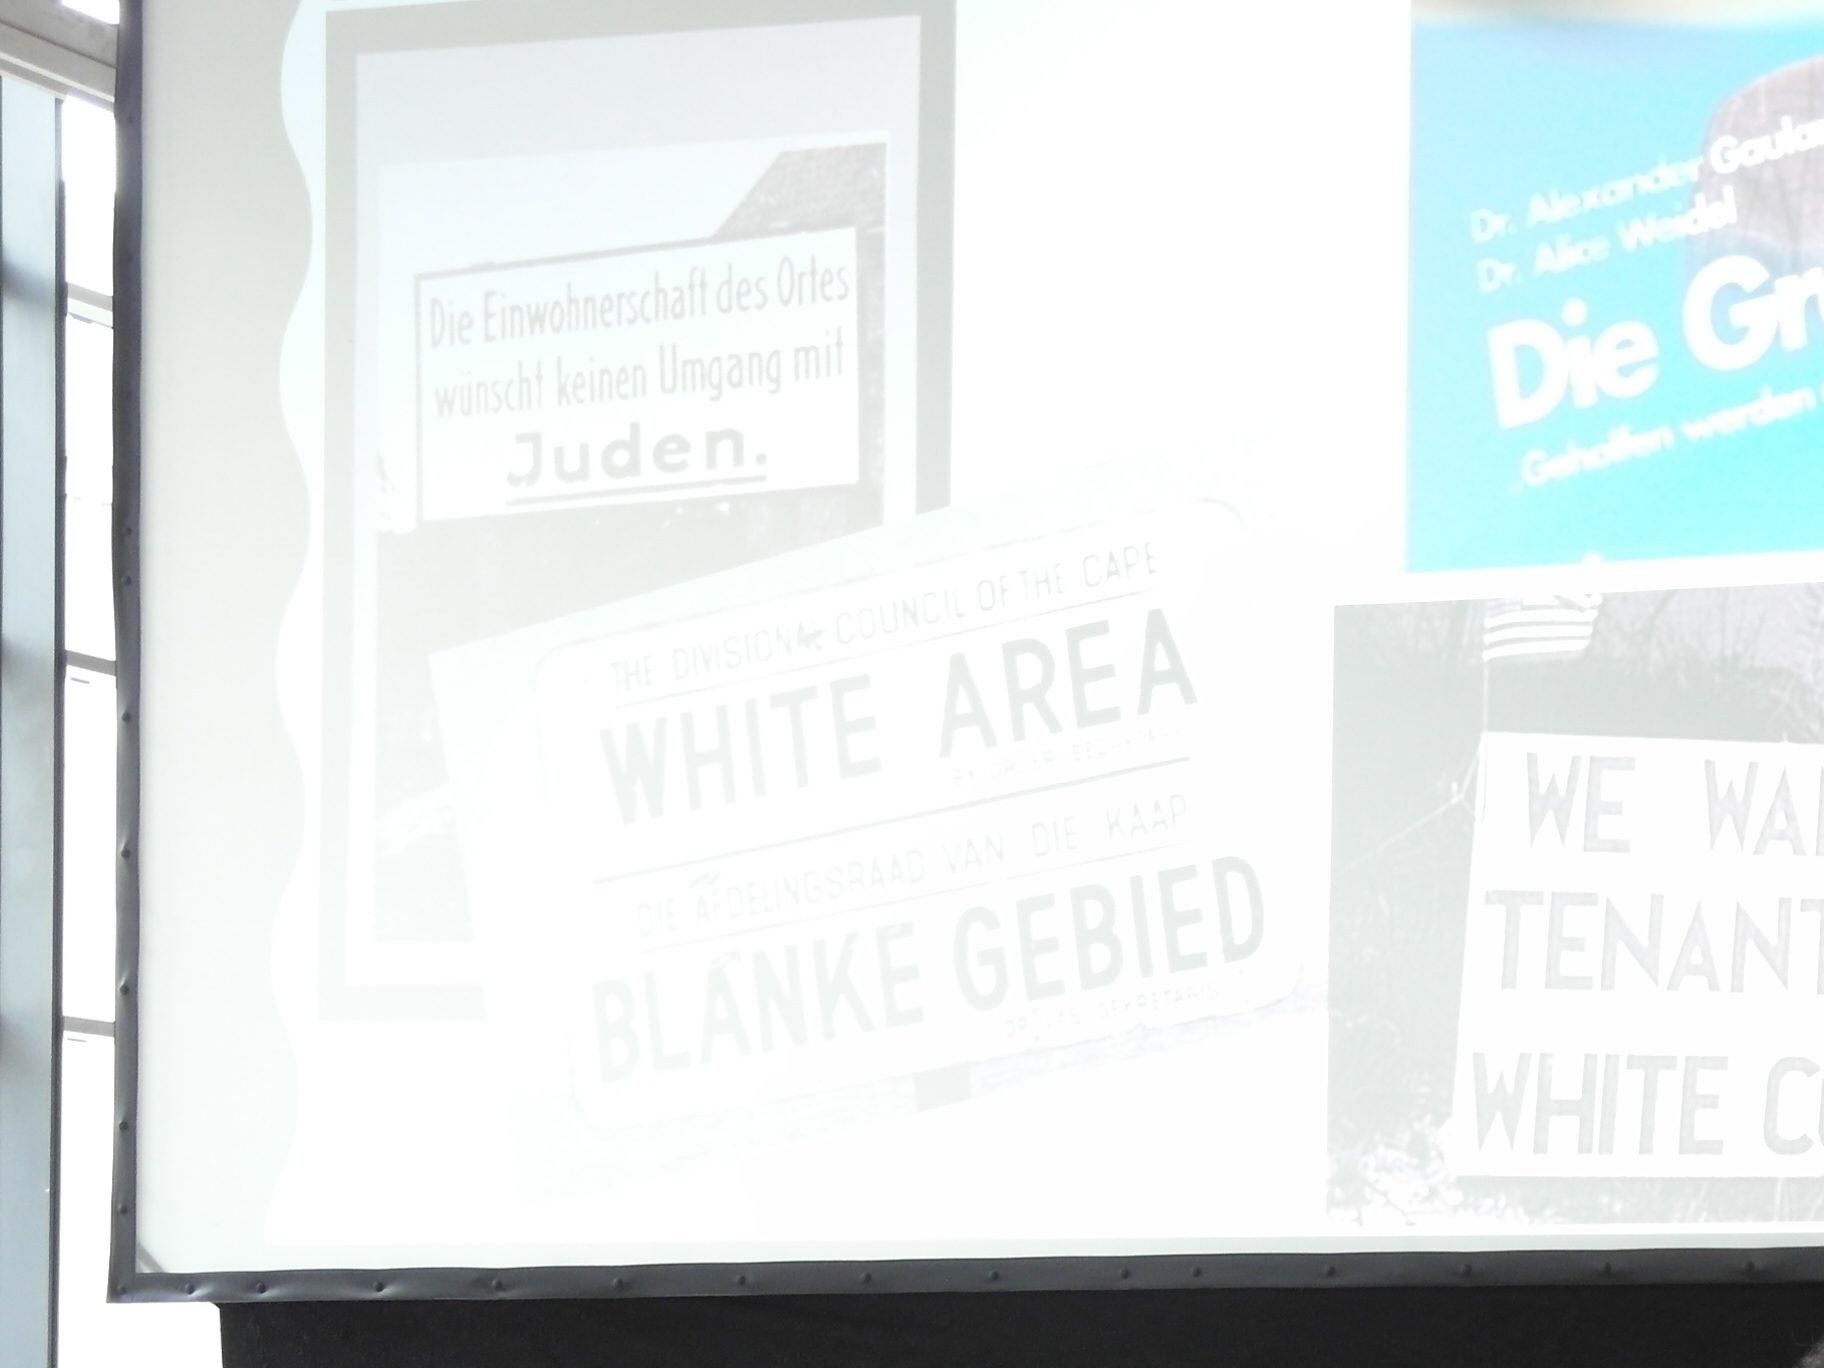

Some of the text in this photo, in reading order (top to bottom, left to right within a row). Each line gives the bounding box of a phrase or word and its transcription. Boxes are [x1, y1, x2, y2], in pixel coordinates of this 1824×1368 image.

[1470, 209, 1517, 246] Dr.
[1525, 154, 1704, 228] Alexander
[1474, 184, 1737, 294] Dr. Alice Weidel
[429, 253, 850, 349] Die Einwohnerschaft des Ortes
[435, 326, 844, 418] wünscht keinen Umgang mit
[1487, 298, 1662, 432] Die
[506, 421, 768, 487] Juden.
[1679, 387, 1818, 448] werden
[610, 655, 656, 693] THE
[835, 588, 964, 647] COUNCIL
[976, 575, 1012, 614] OF
[1018, 560, 1068, 601] THE
[1082, 540, 1160, 588] CAPE
[600, 607, 1200, 826] WHITE AREA
[942, 832, 1006, 875] VAN
[1032, 816, 1079, 859] DIE
[1105, 792, 1189, 840] KAAP
[1527, 752, 1636, 853] WE
[592, 855, 1267, 1084] BLANKE GEBIED
[1473, 1052, 1728, 1155] WHITE
